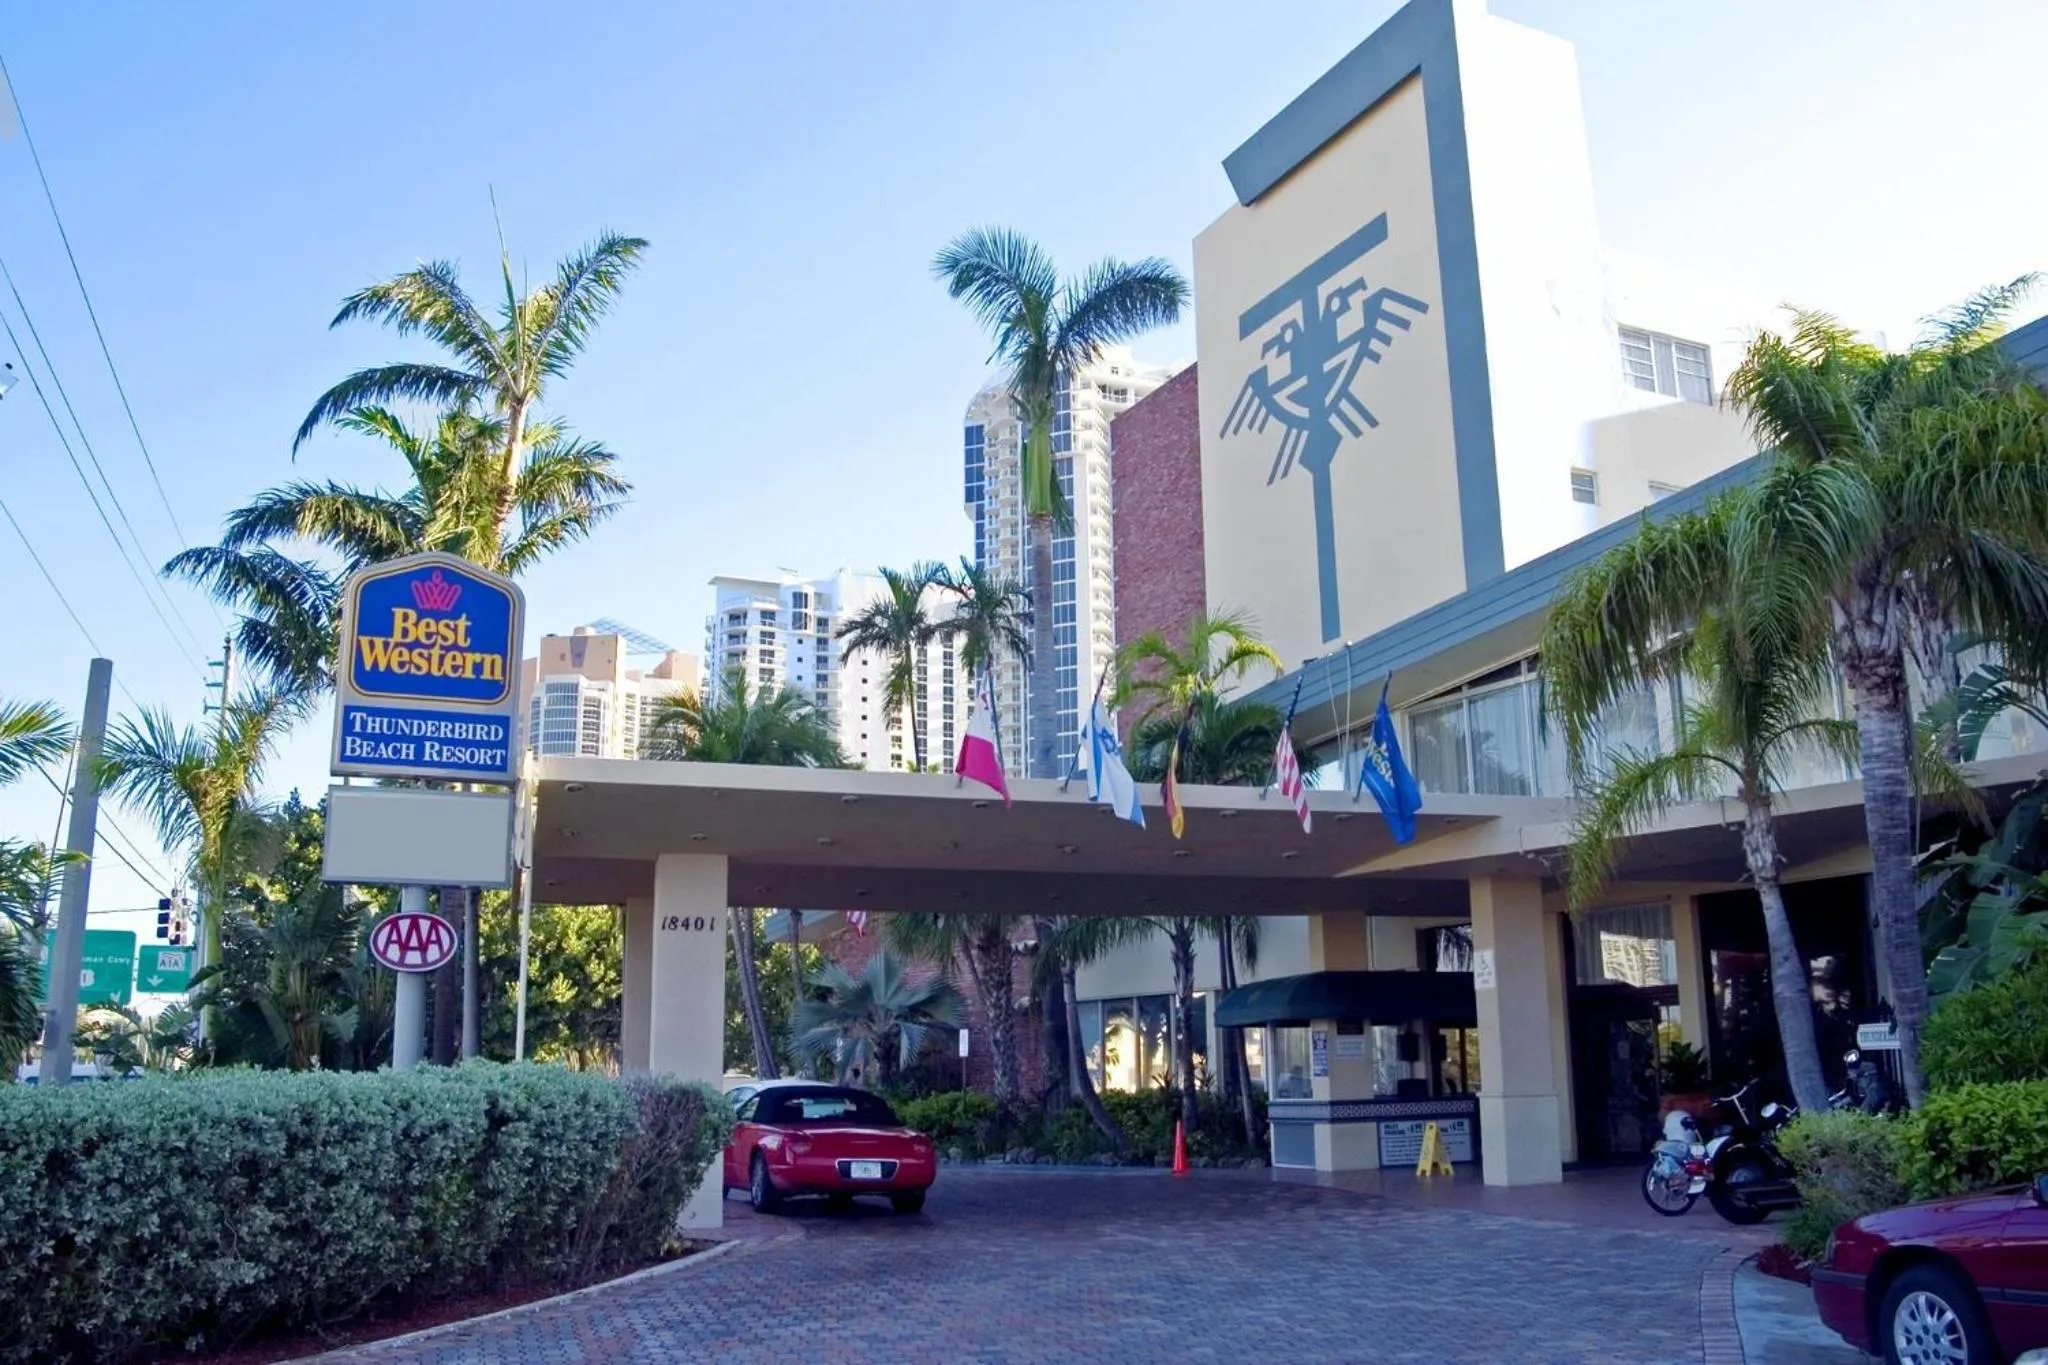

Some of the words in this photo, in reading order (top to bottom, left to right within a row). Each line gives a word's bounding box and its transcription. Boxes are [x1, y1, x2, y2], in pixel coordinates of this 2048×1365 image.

[392, 607, 472, 647] Best
[358, 636, 504, 681] Western
[350, 712, 503, 741] THUNDERBIRD
[344, 736, 416, 760] BEACH
[423, 741, 506, 765] RESORT
[379, 914, 450, 966] AAA
[661, 915, 716, 931] 18401
